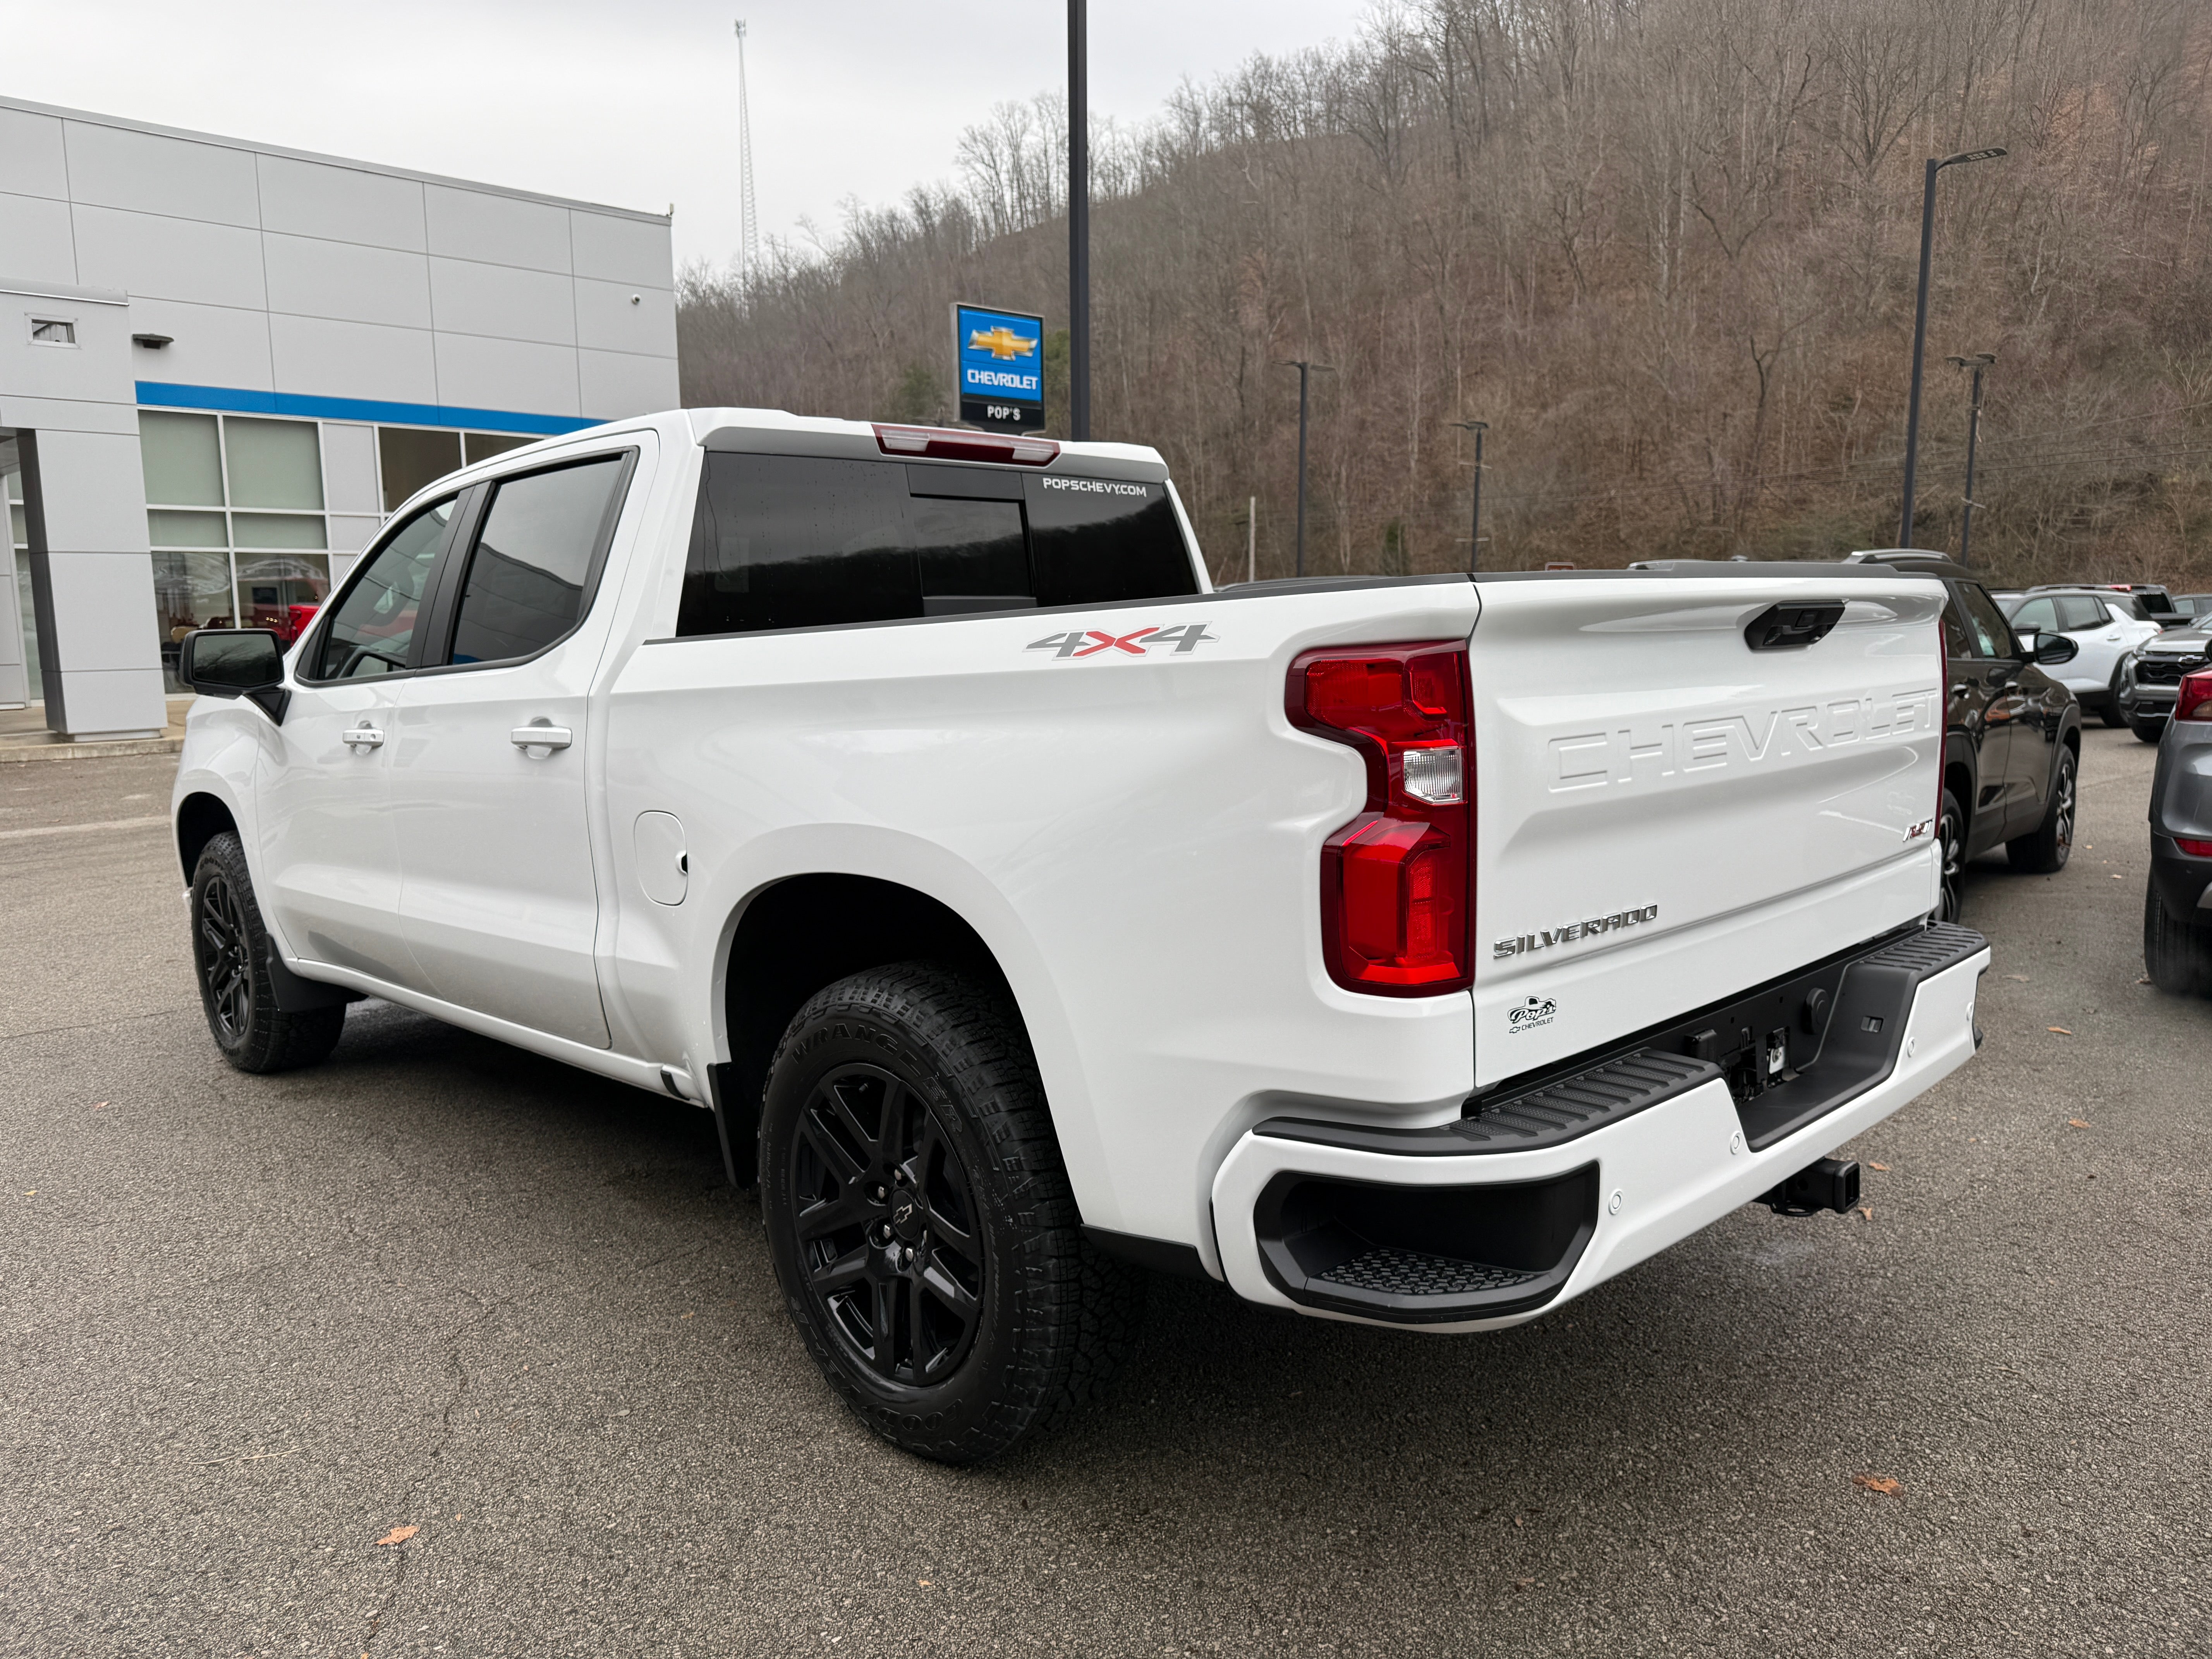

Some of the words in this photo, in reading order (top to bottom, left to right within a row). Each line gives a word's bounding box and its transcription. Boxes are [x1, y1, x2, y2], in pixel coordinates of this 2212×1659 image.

[967, 369, 1038, 390] CHEVROLET
[987, 405, 1020, 421] POP'S
[1042, 477, 1147, 497] POPSCHEVY.COM
[1547, 687, 1938, 793] CHEVROLET
[1493, 903, 1658, 959] SILVERADO
[1522, 1017, 1554, 1030] CHEVROLET
[791, 1022, 963, 1135] WRANGLER
